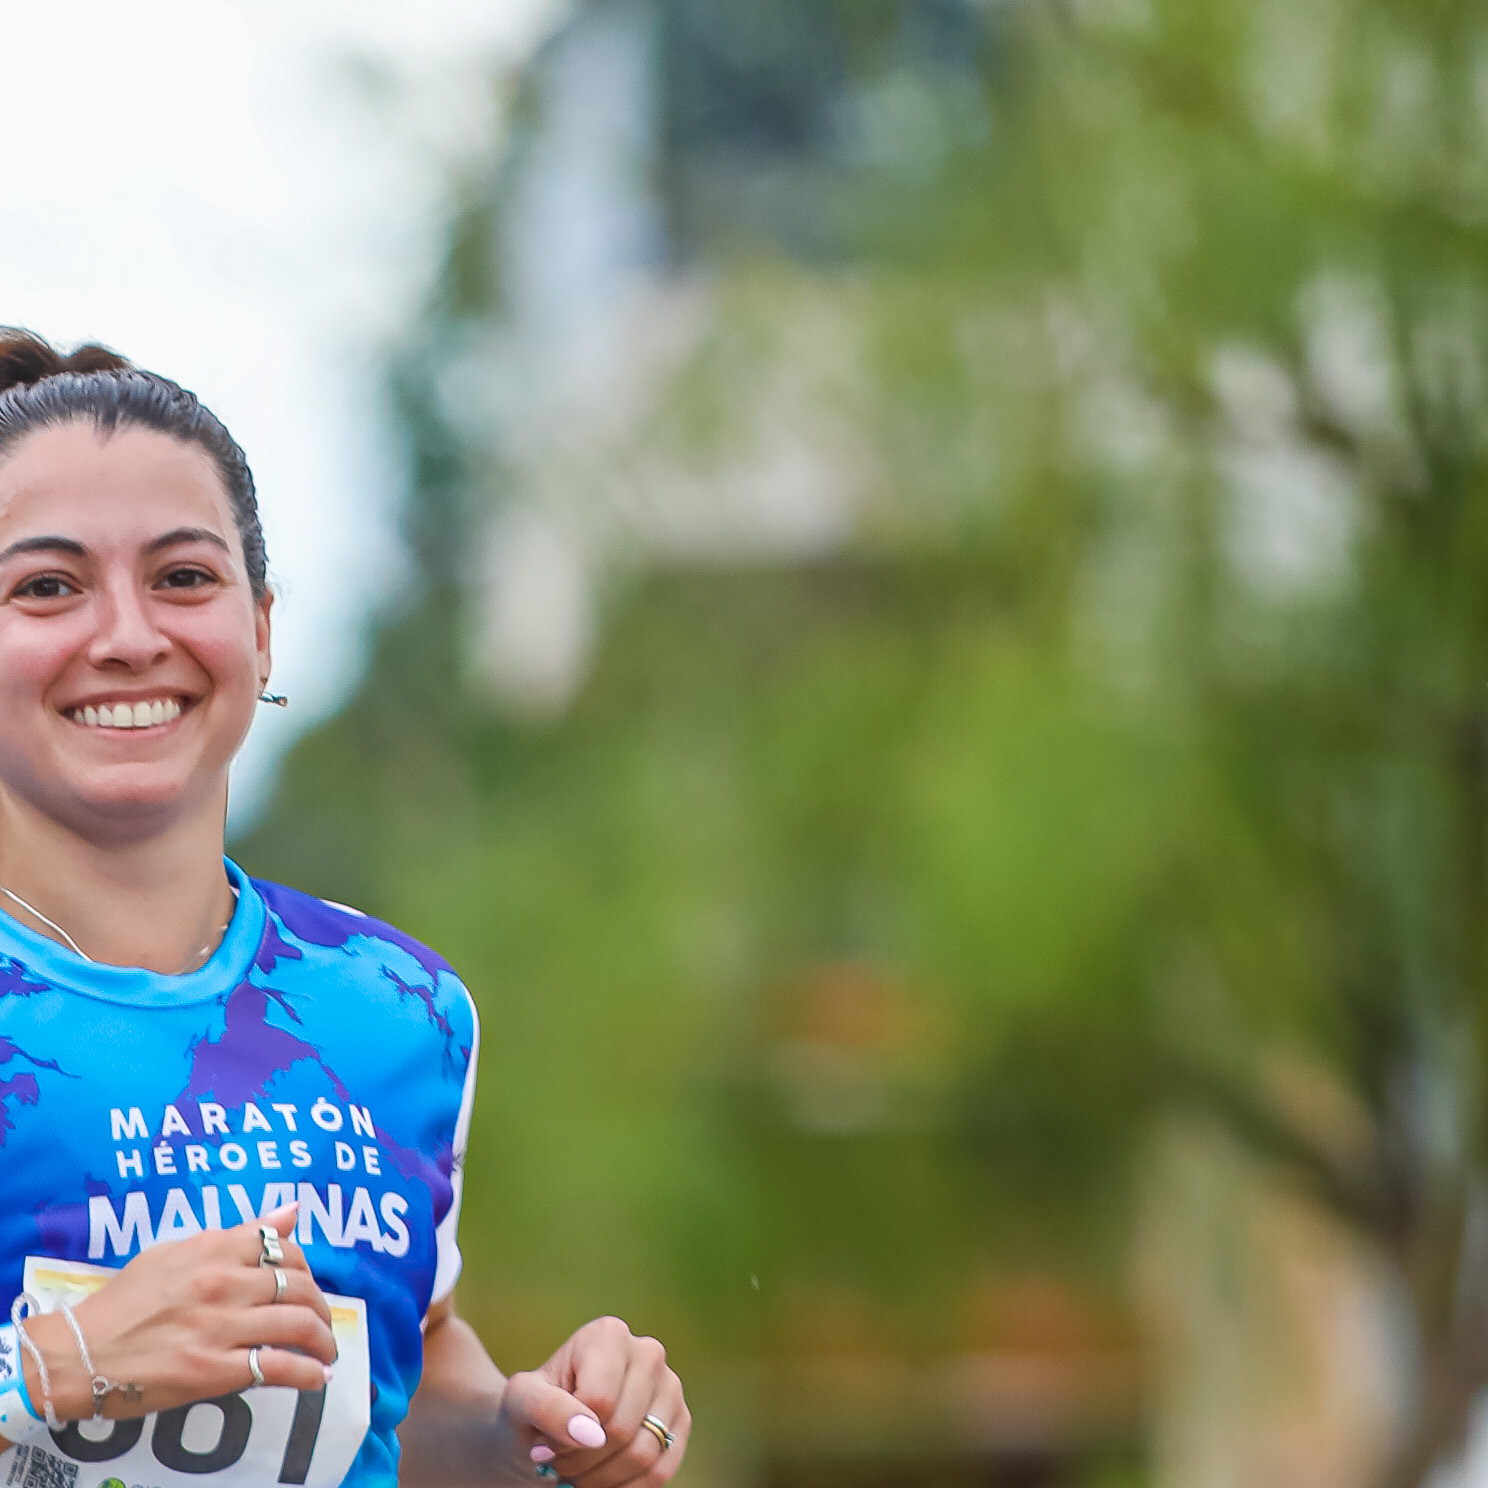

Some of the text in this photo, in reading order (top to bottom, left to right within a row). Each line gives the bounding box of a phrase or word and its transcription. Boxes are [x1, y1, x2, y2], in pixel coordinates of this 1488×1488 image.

[110, 1098, 378, 1140] MARATÓN
[117, 1141, 383, 1178] HÉROES DE
